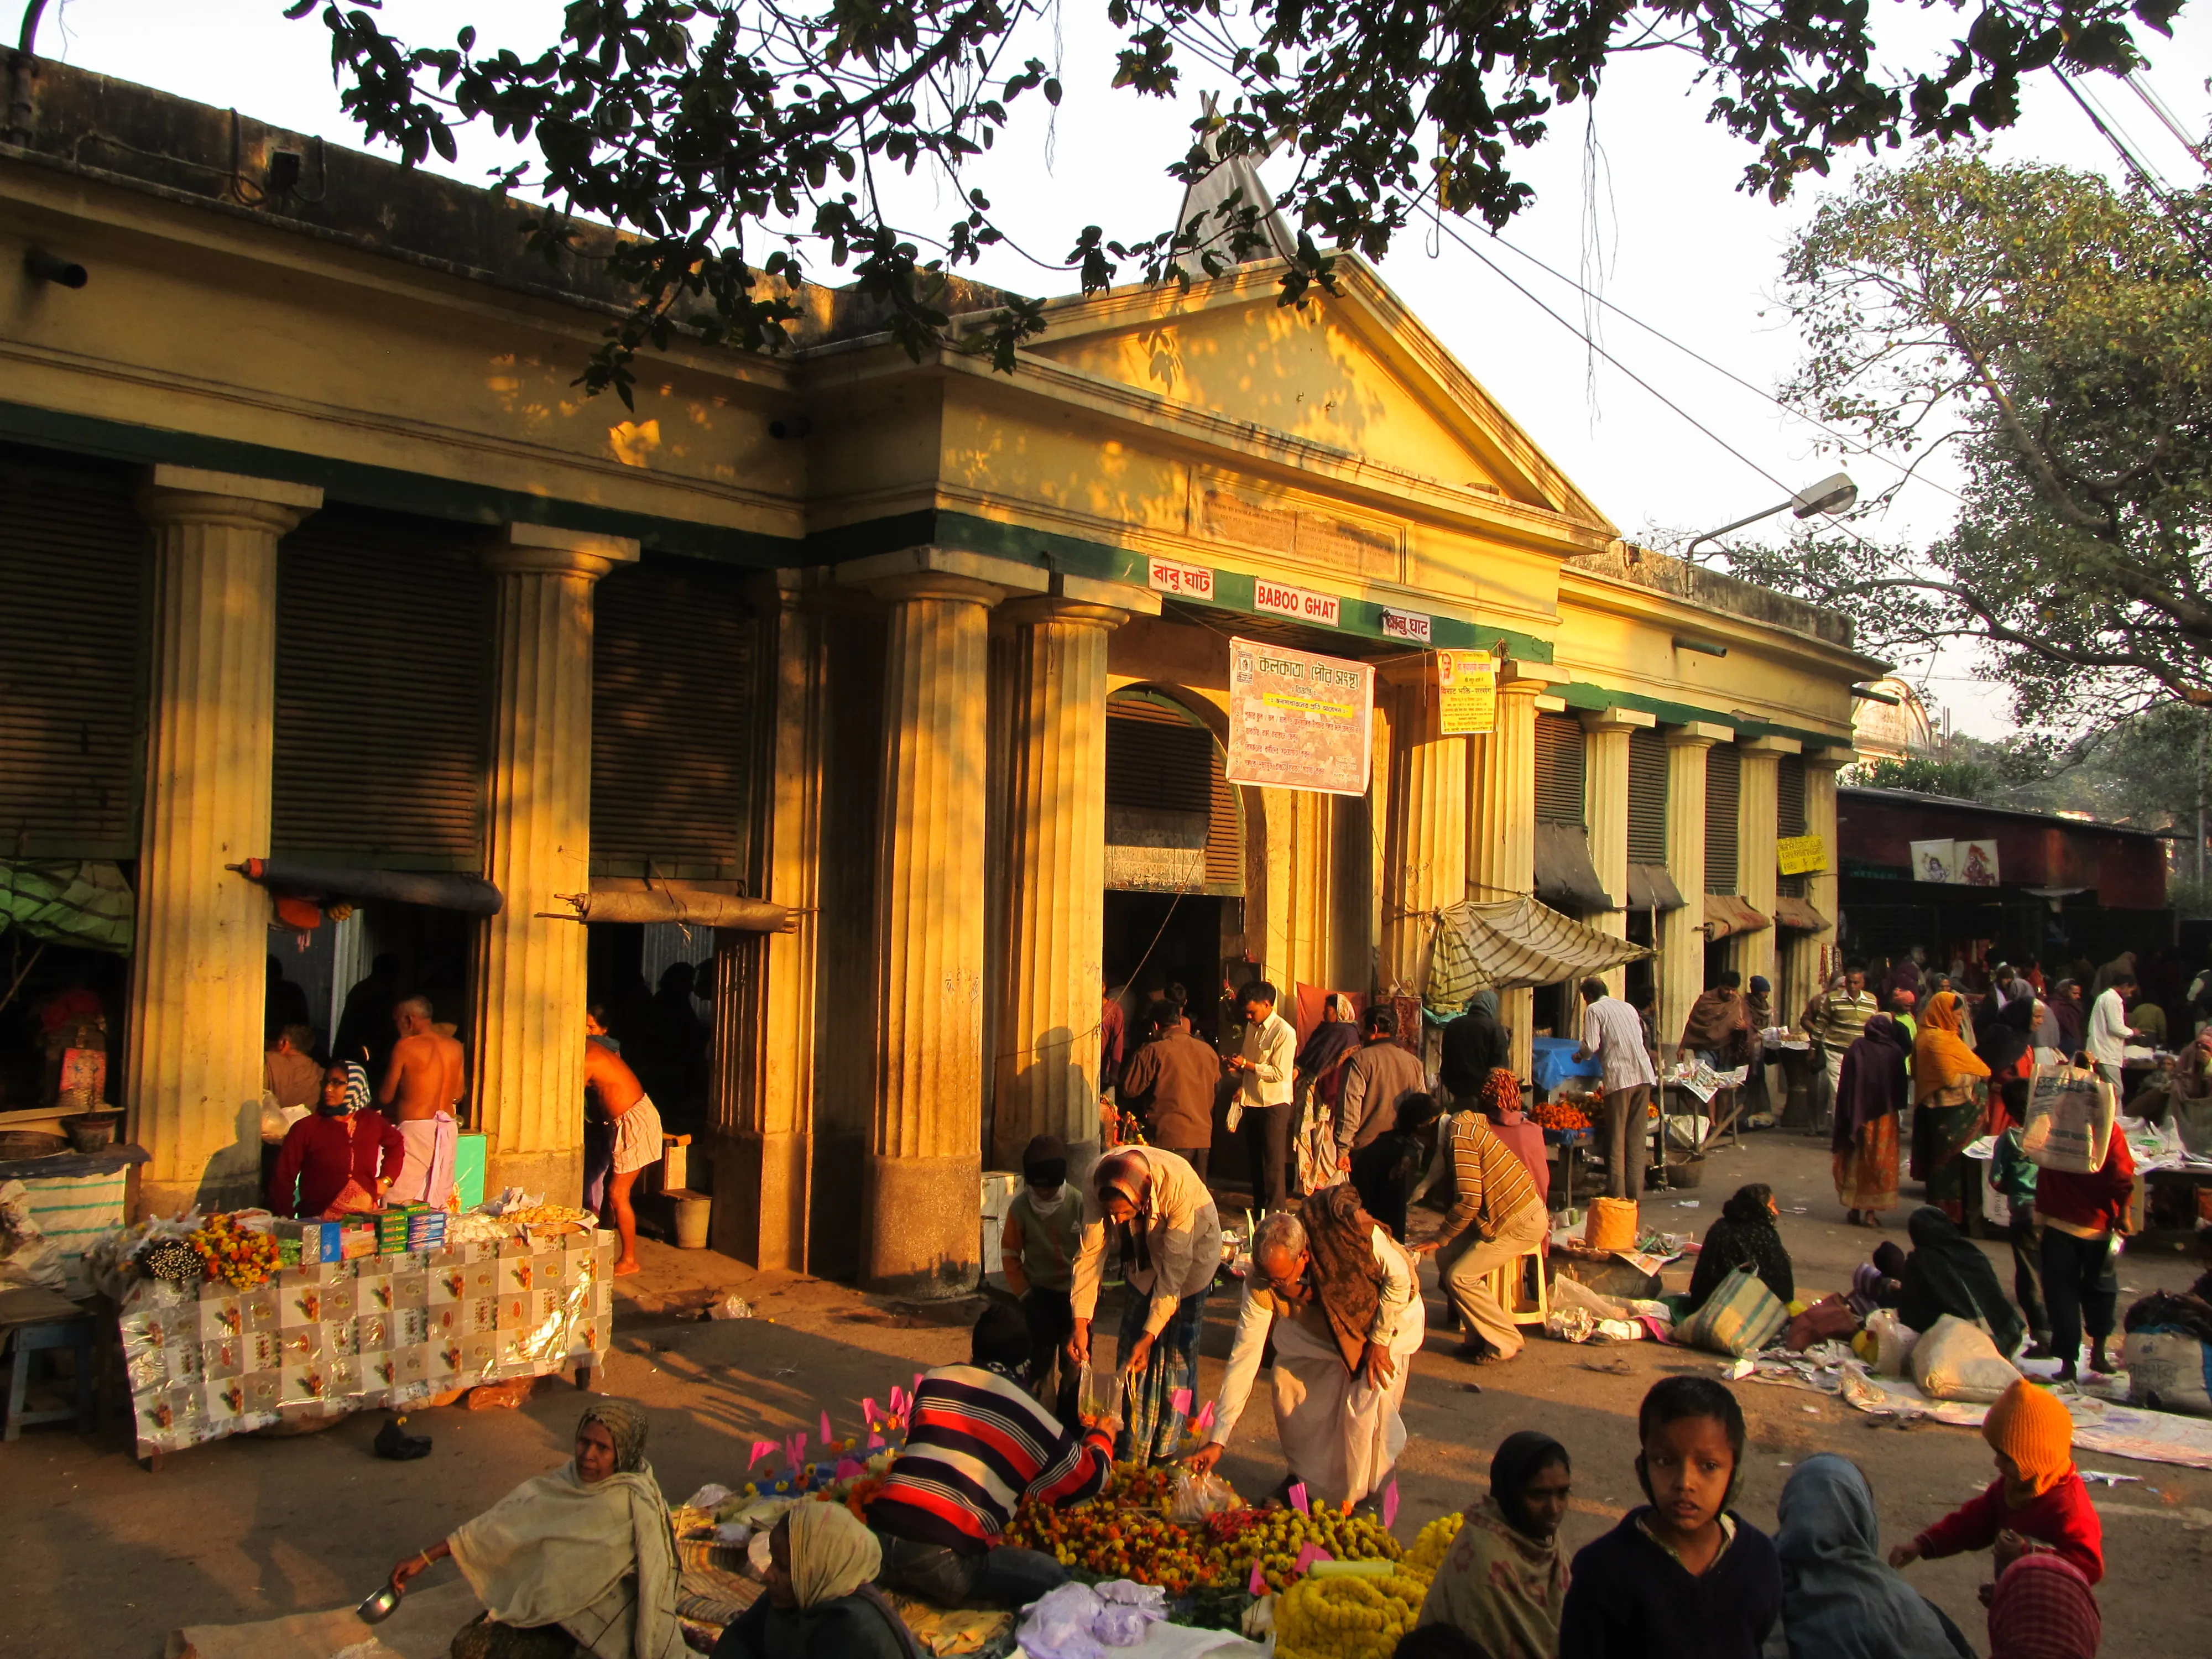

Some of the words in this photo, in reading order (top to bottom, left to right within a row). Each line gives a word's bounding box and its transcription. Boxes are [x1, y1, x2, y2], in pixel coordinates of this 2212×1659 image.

[1153, 565, 1183, 591] বাবু
[1183, 569, 1211, 592] ঘাট
[1258, 586, 1298, 611] BABOO
[1305, 597, 1335, 619] GHAT
[1409, 618, 1428, 635] घाट
[1259, 656, 1305, 678] কলকাতা
[1311, 662, 1332, 686] পৌর
[1335, 669, 1359, 689] সংস্থা
[1441, 686, 1456, 695] विराट
